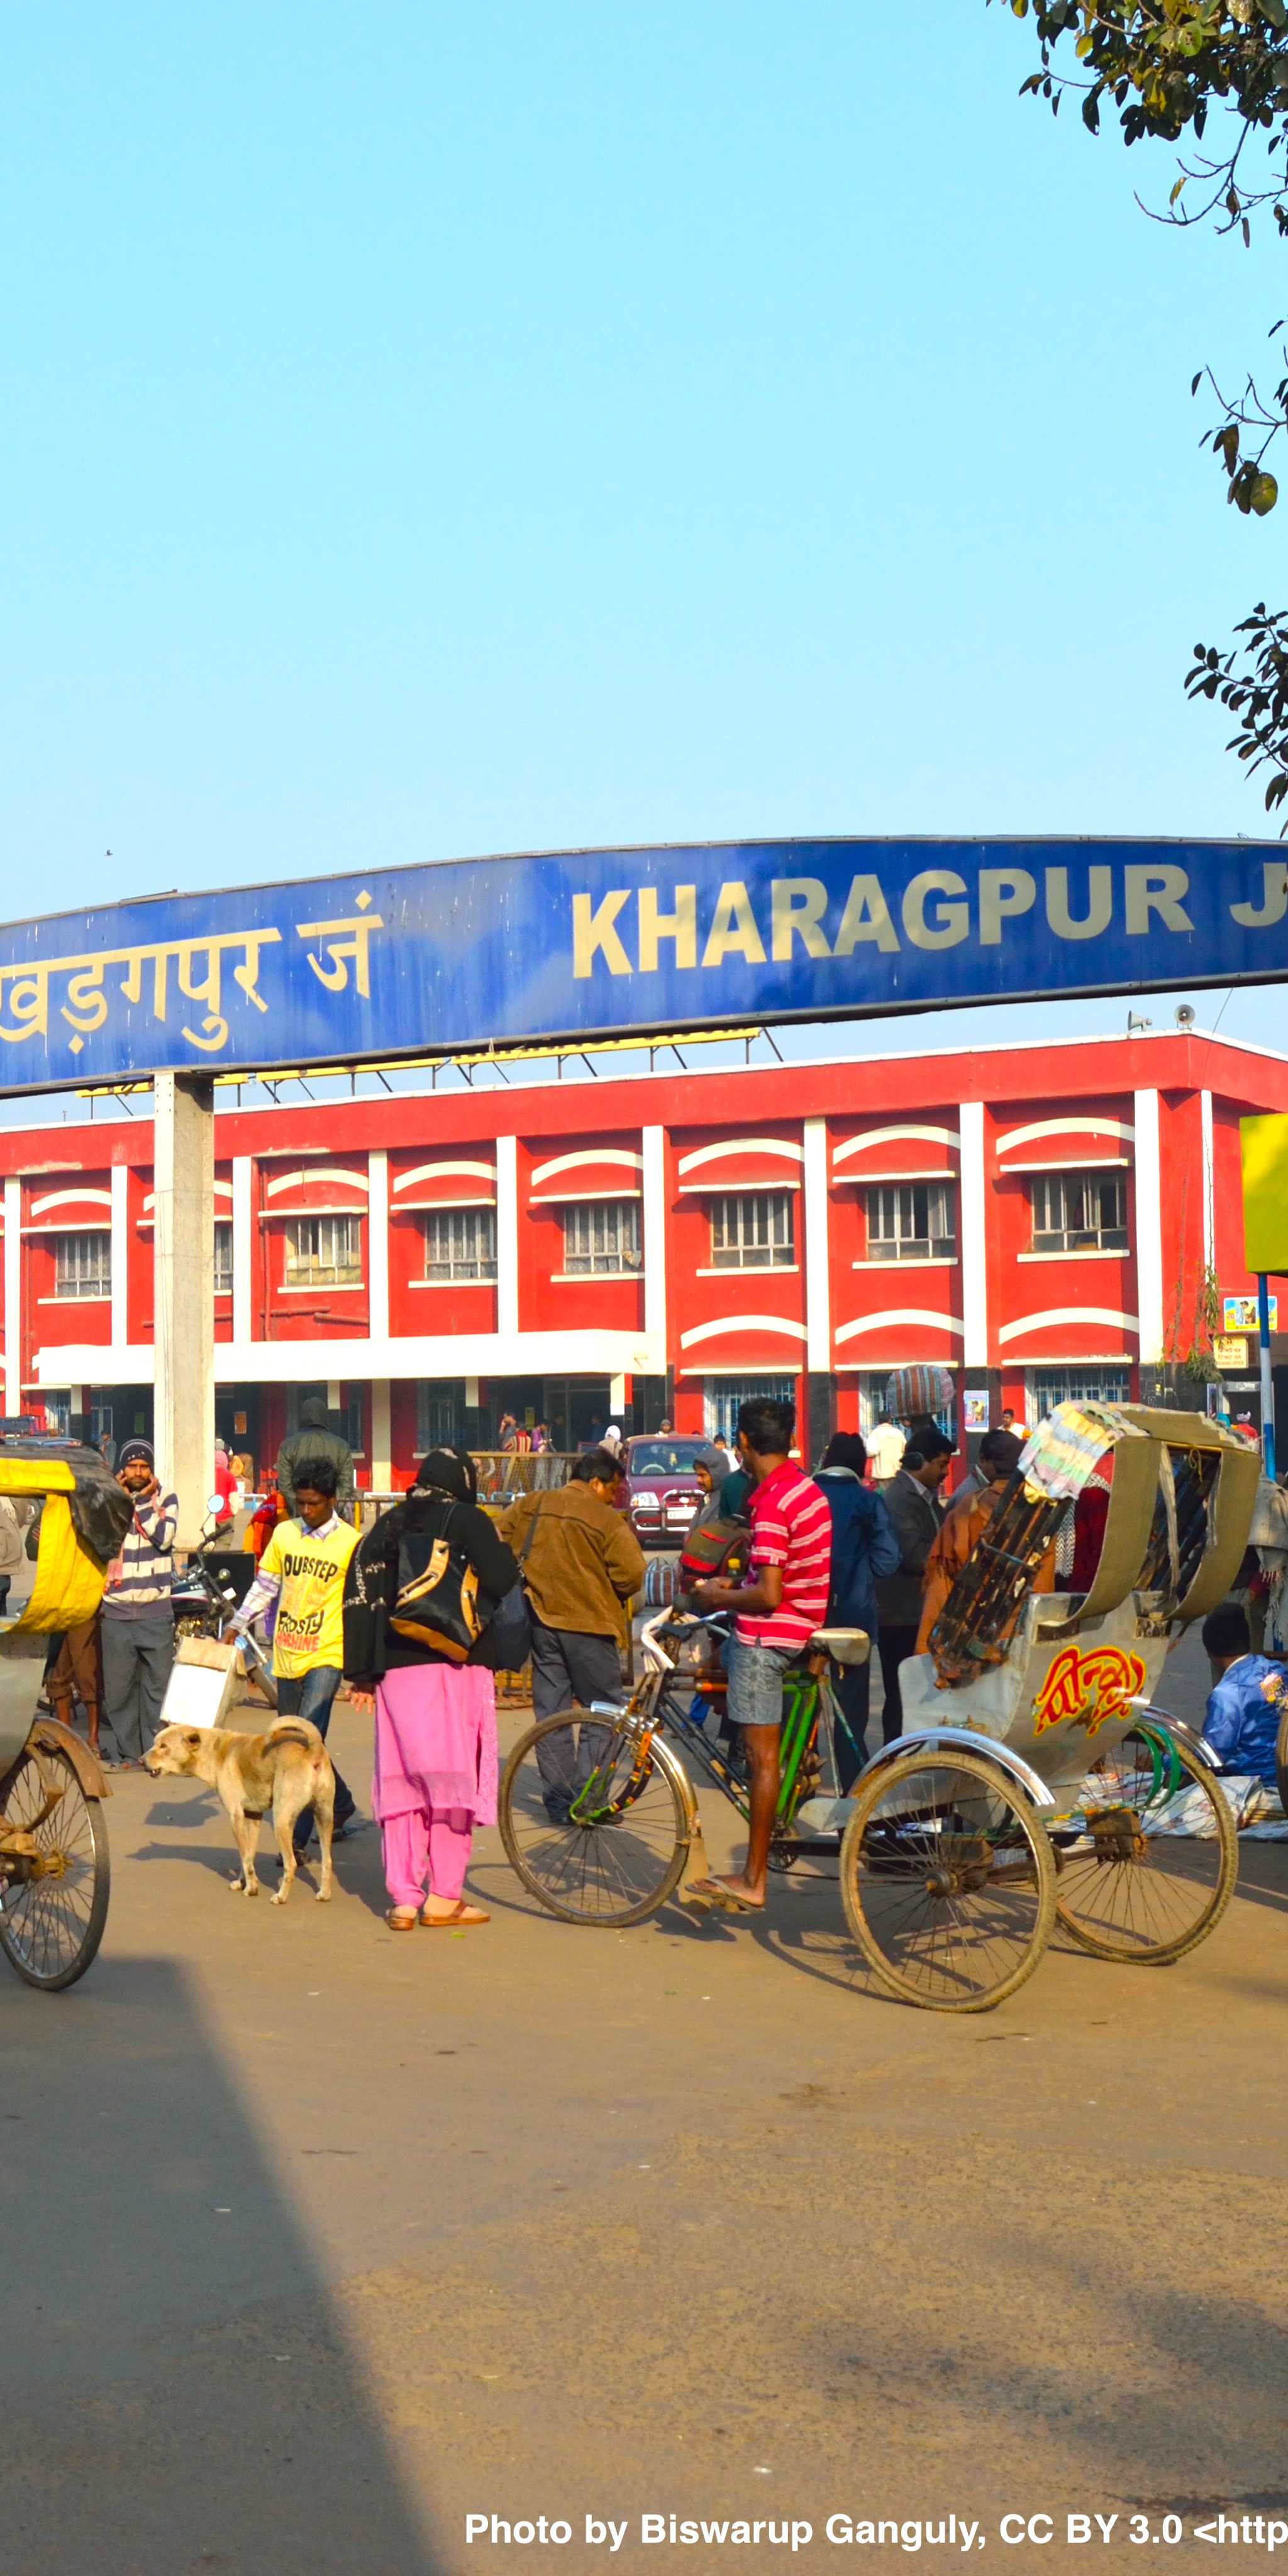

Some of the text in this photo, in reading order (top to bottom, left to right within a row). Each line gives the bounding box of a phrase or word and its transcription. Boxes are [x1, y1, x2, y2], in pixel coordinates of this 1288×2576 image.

[573, 864, 1195, 978] KHARAGPUR
[0, 890, 384, 1053] खड़गपुर जं
[284, 1553, 338, 1582] DUBSTEP
[278, 1609, 325, 1635] FROSTY
